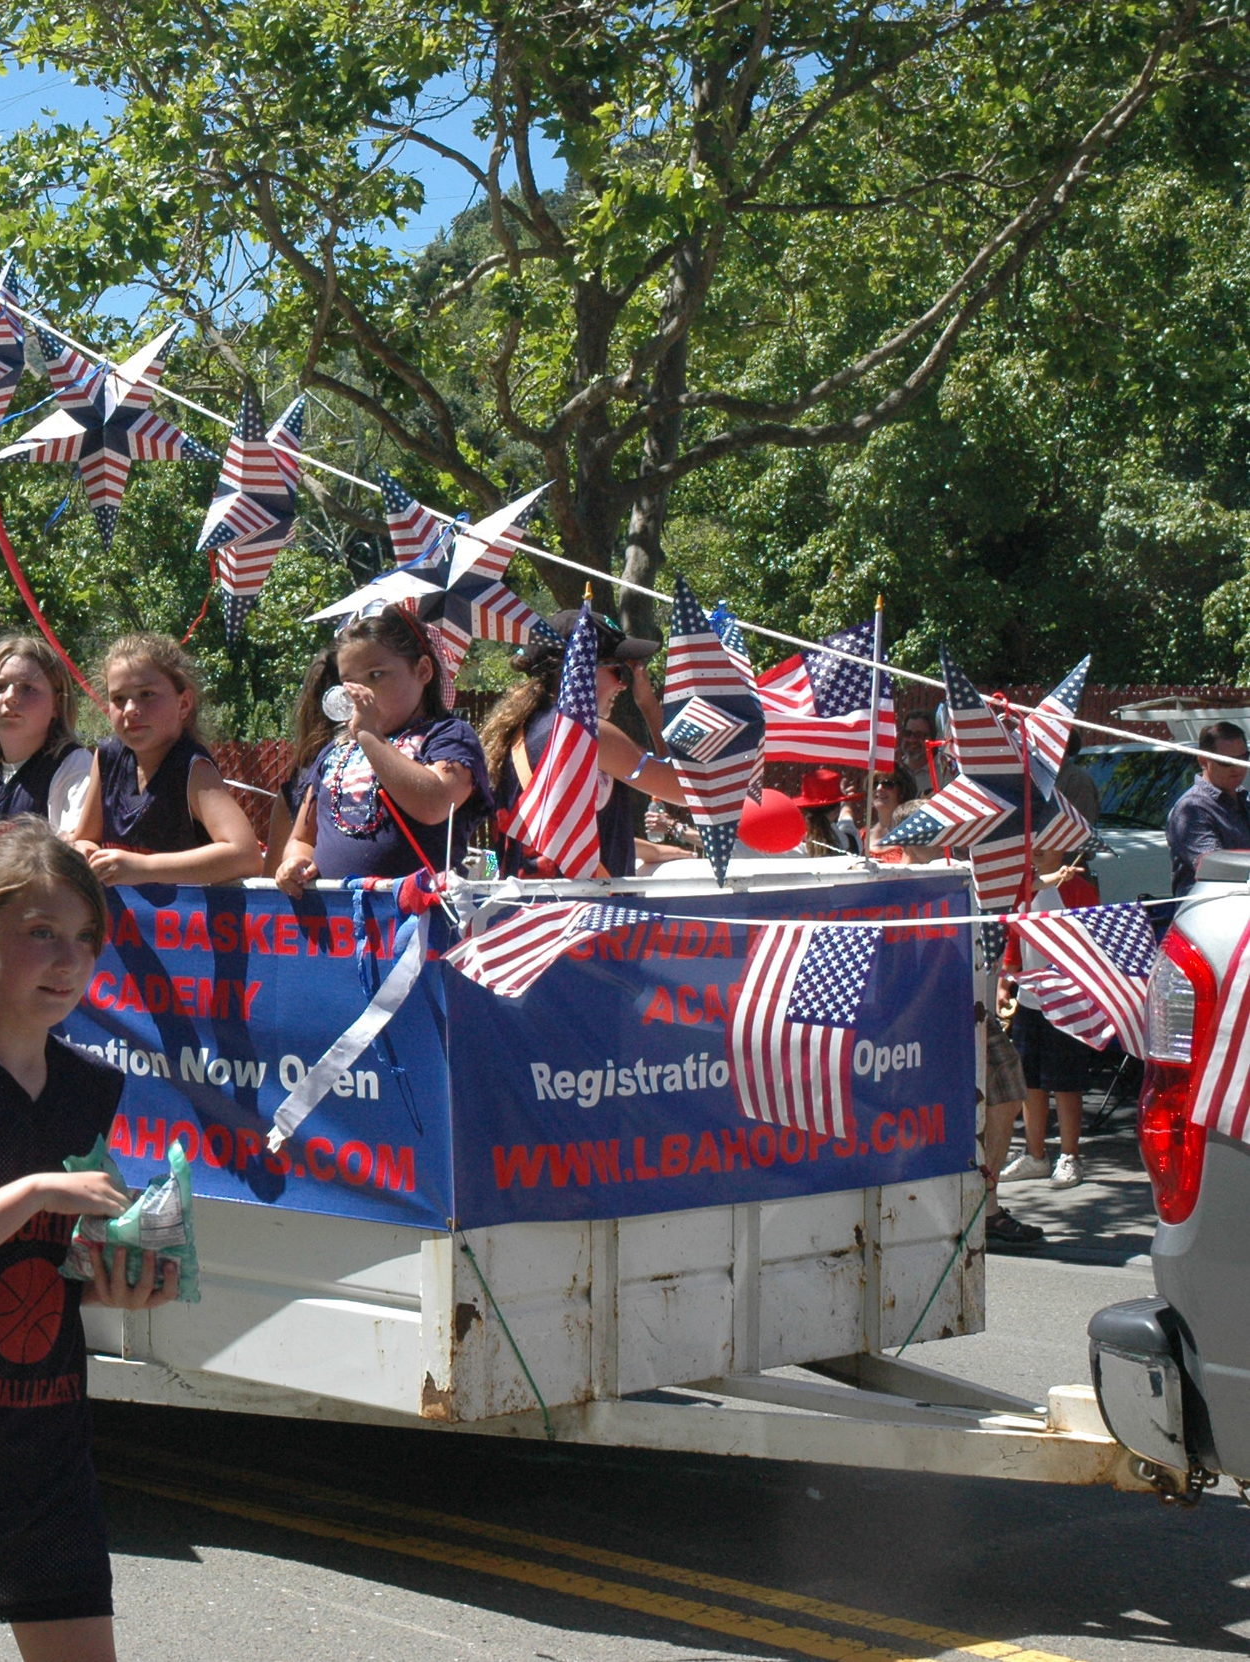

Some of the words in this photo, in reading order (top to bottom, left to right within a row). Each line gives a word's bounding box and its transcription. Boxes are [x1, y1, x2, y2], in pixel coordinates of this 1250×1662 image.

[80, 970, 263, 1021] CADEMY
[180, 1046, 267, 1089] Now
[279, 1054, 379, 1100] Oen
[530, 1052, 730, 1108] Registratio
[853, 1039, 921, 1083] Open
[108, 1113, 416, 1193] AHOOPS.COM
[492, 1103, 946, 1190] WWW.LBAHOOPS.COM
